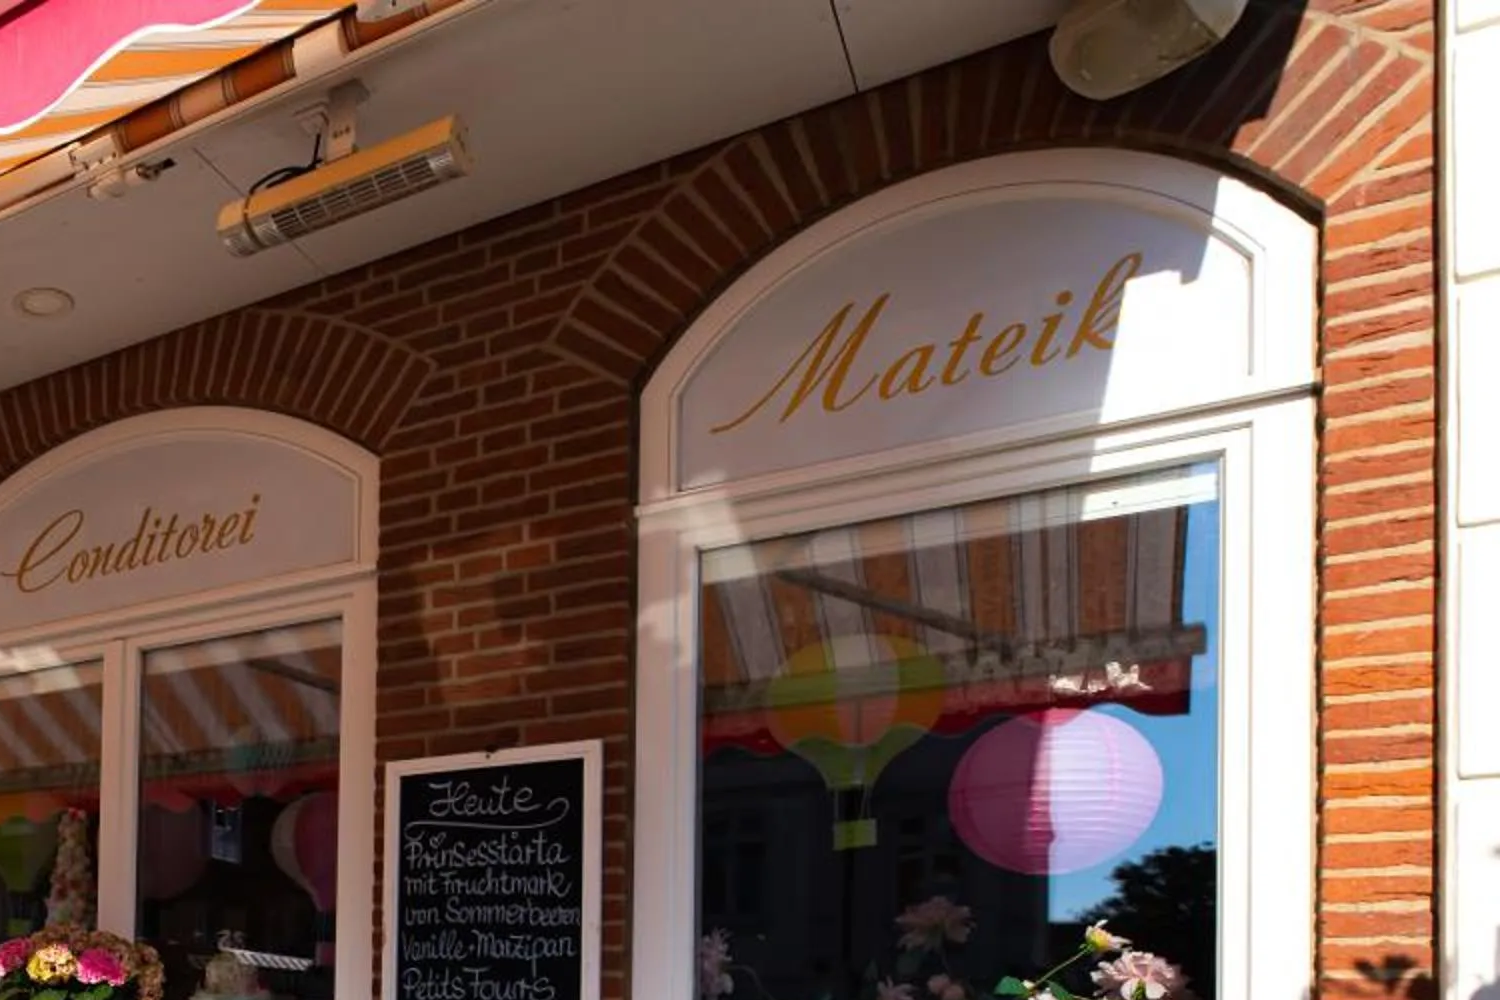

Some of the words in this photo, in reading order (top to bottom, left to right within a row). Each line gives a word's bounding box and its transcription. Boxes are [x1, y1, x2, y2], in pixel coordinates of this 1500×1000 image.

[0, 494, 260, 592] Conditorei
[428, 775, 542, 817] Heute
[404, 871, 438, 896] mit
[439, 867, 572, 899] Fruchtmark
[405, 906, 442, 926] von
